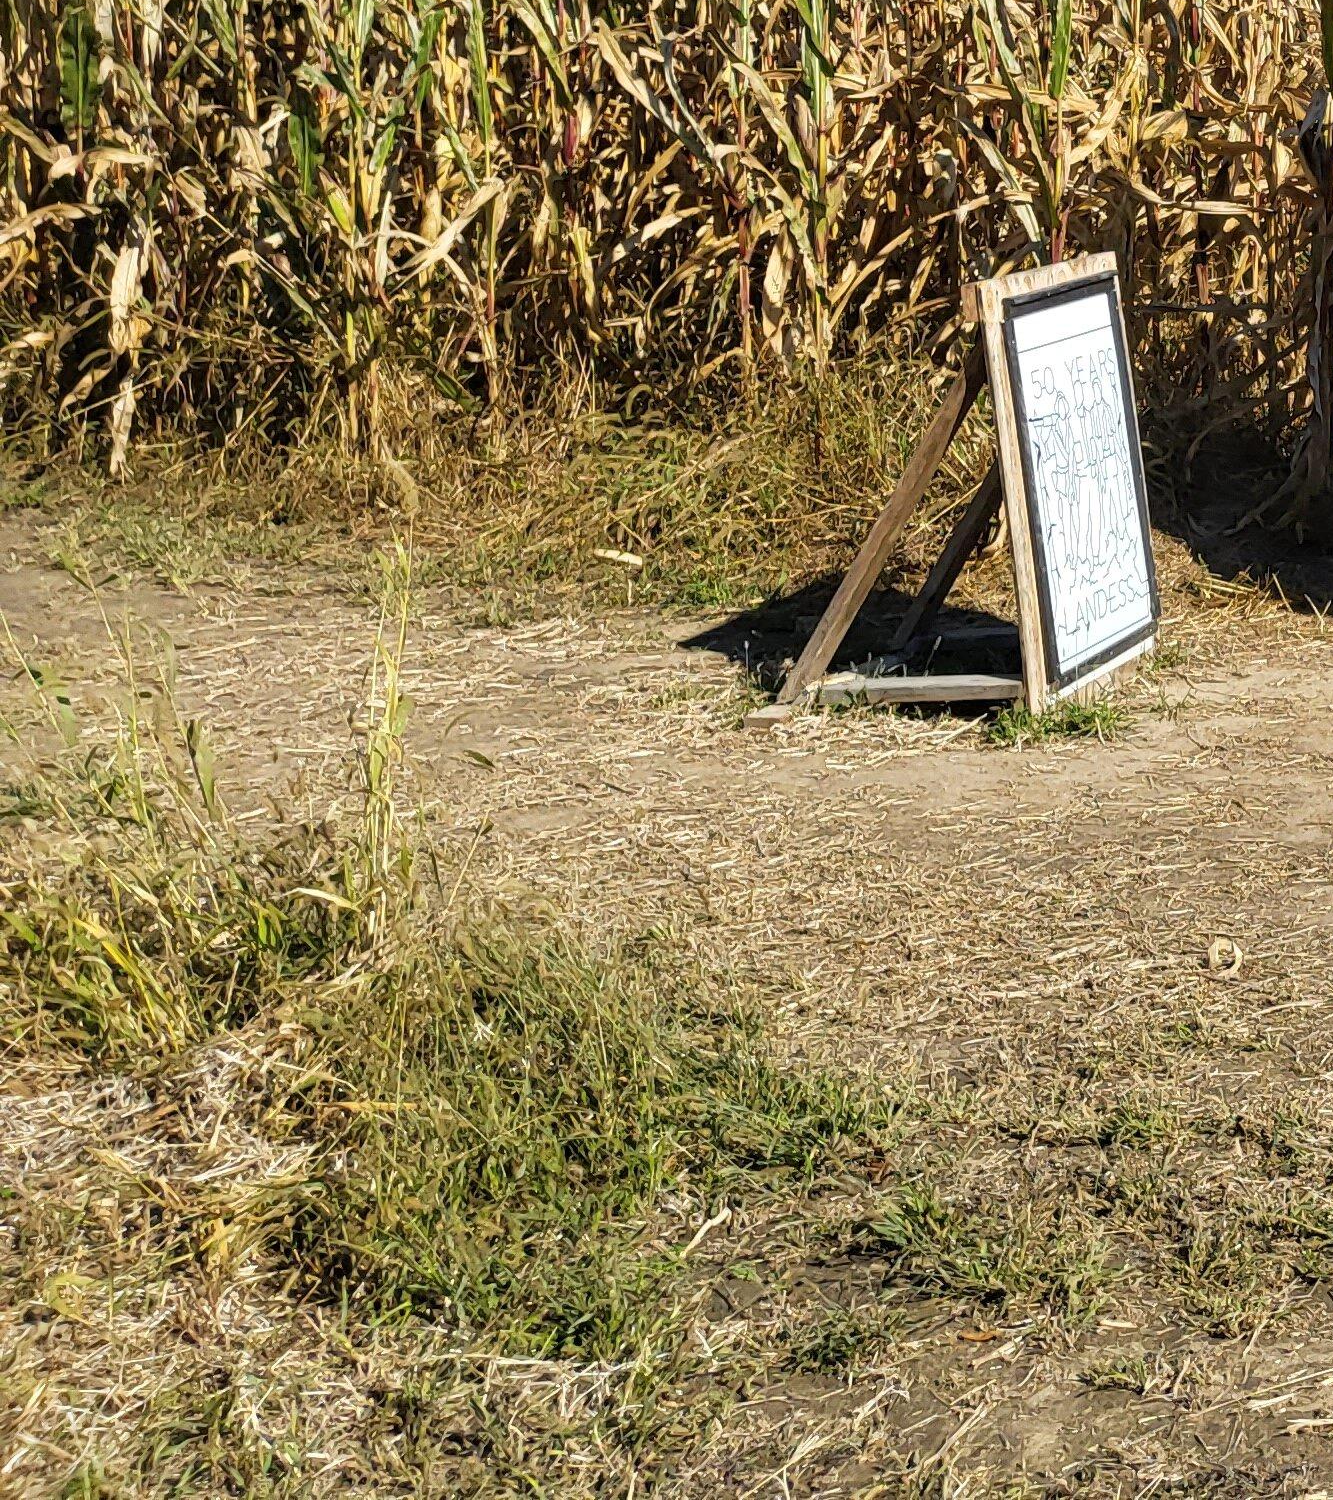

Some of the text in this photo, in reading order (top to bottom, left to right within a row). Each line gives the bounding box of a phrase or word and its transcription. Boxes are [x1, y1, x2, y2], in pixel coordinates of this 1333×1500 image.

[1030, 347, 1116, 400] 50 YEARS
[1063, 574, 1135, 637] LANDESS
